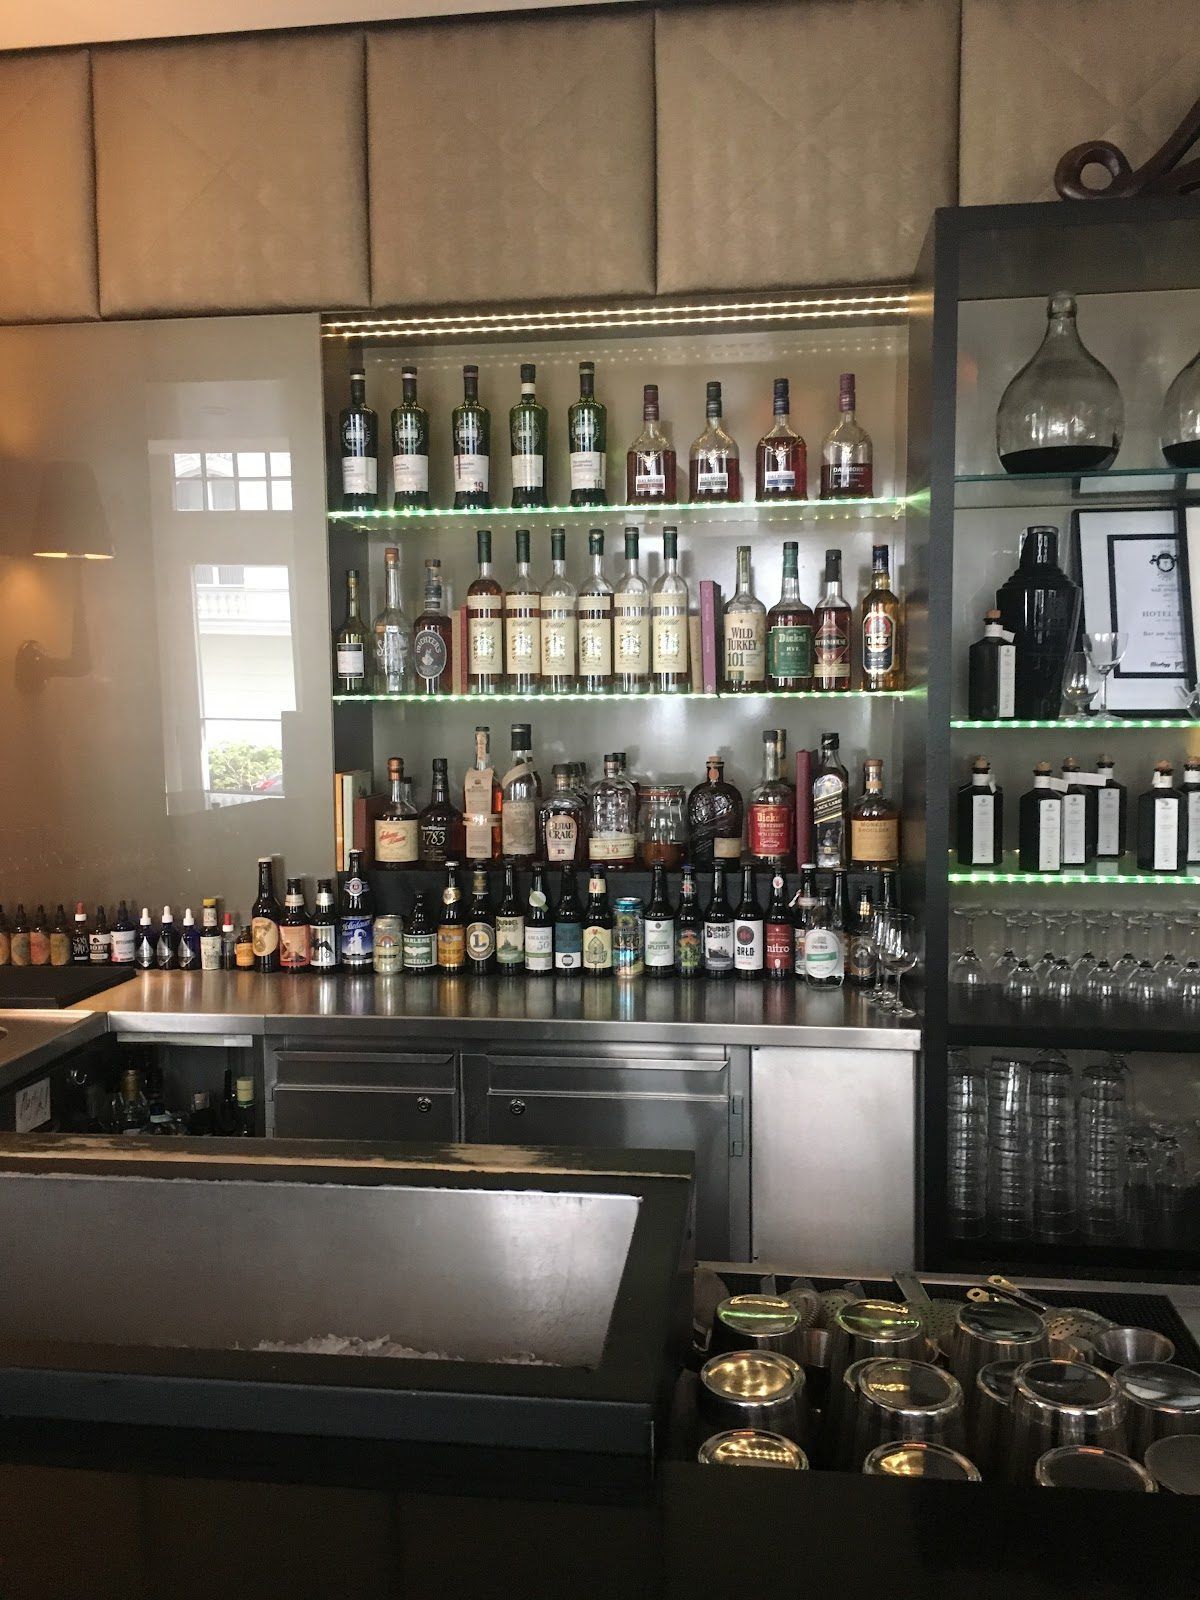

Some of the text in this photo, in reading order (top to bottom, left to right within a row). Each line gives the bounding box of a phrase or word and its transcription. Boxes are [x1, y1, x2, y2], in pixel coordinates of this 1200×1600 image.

[1142, 610, 1173, 618] HOTEL
[731, 627, 753, 639] WILD
[727, 638, 757, 650] TURKEY
[728, 652, 744, 667] 101
[422, 831, 446, 845] 1783
[549, 830, 574, 840] CRAIG
[767, 943, 790, 953] nitro
